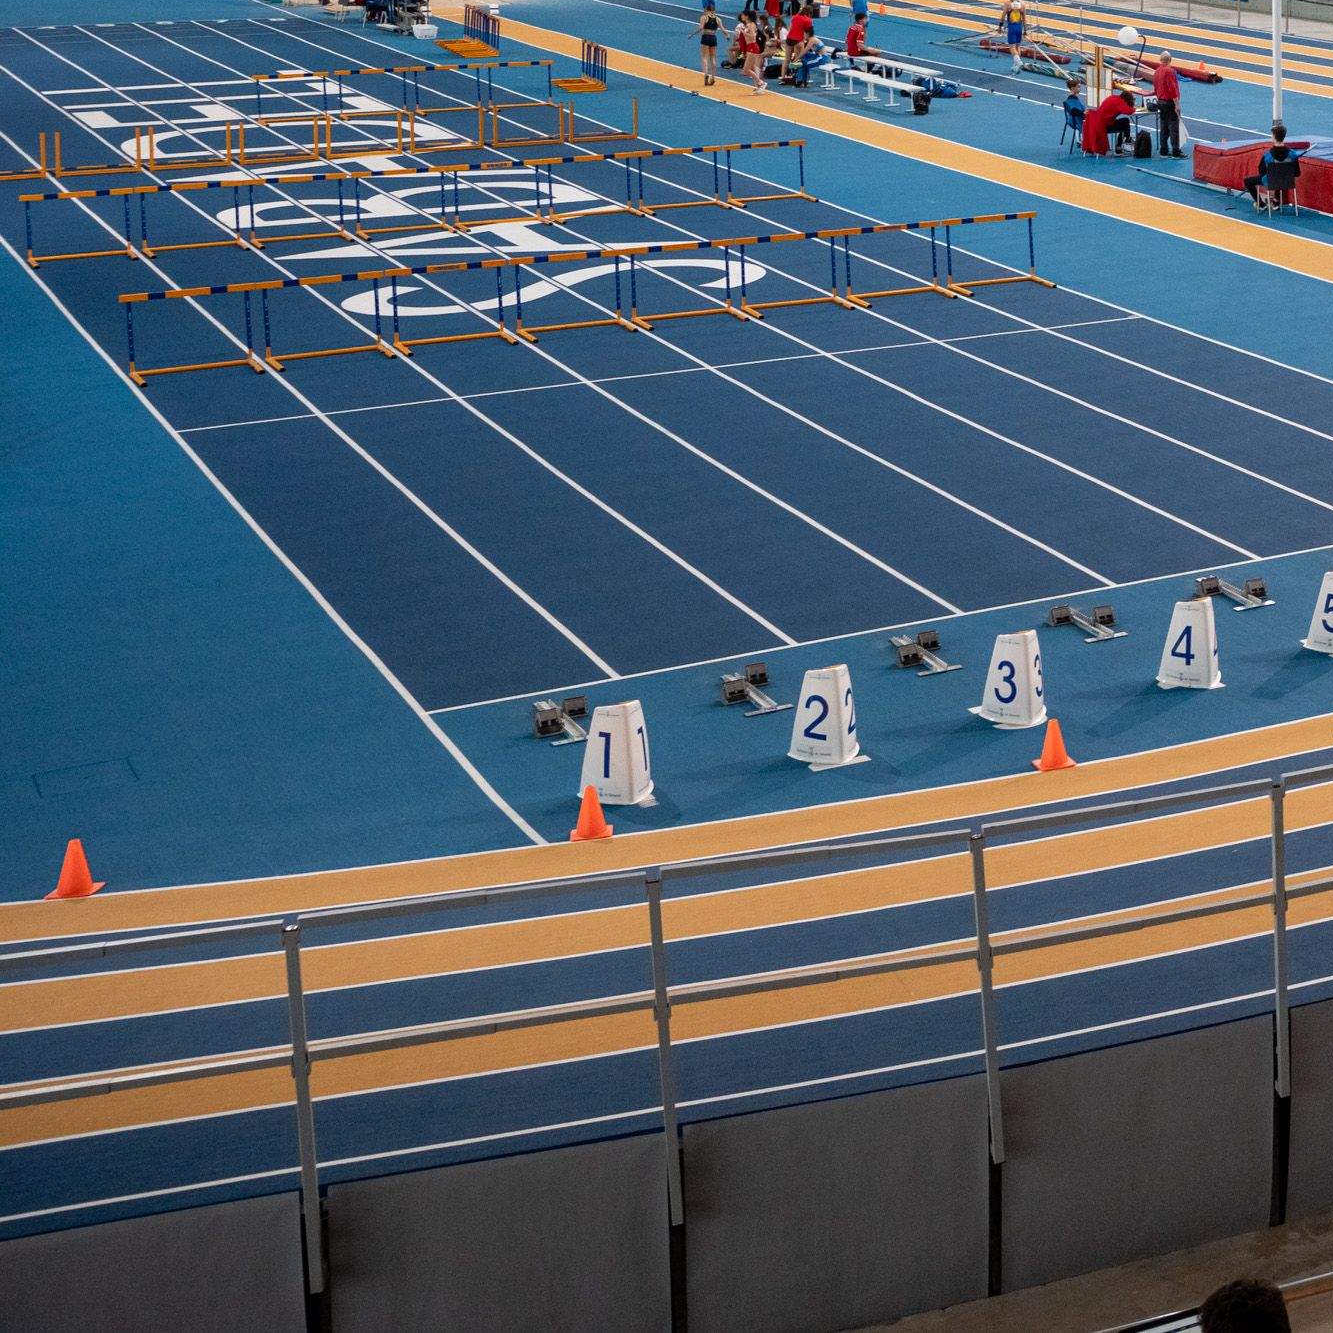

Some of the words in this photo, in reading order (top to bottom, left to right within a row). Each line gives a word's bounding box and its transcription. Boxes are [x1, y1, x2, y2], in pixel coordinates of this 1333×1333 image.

[1171, 626, 1195, 666] 4
[994, 660, 1017, 704] 3
[804, 695, 829, 741] 2
[599, 731, 612, 778] 1
[637, 726, 648, 771] 1
